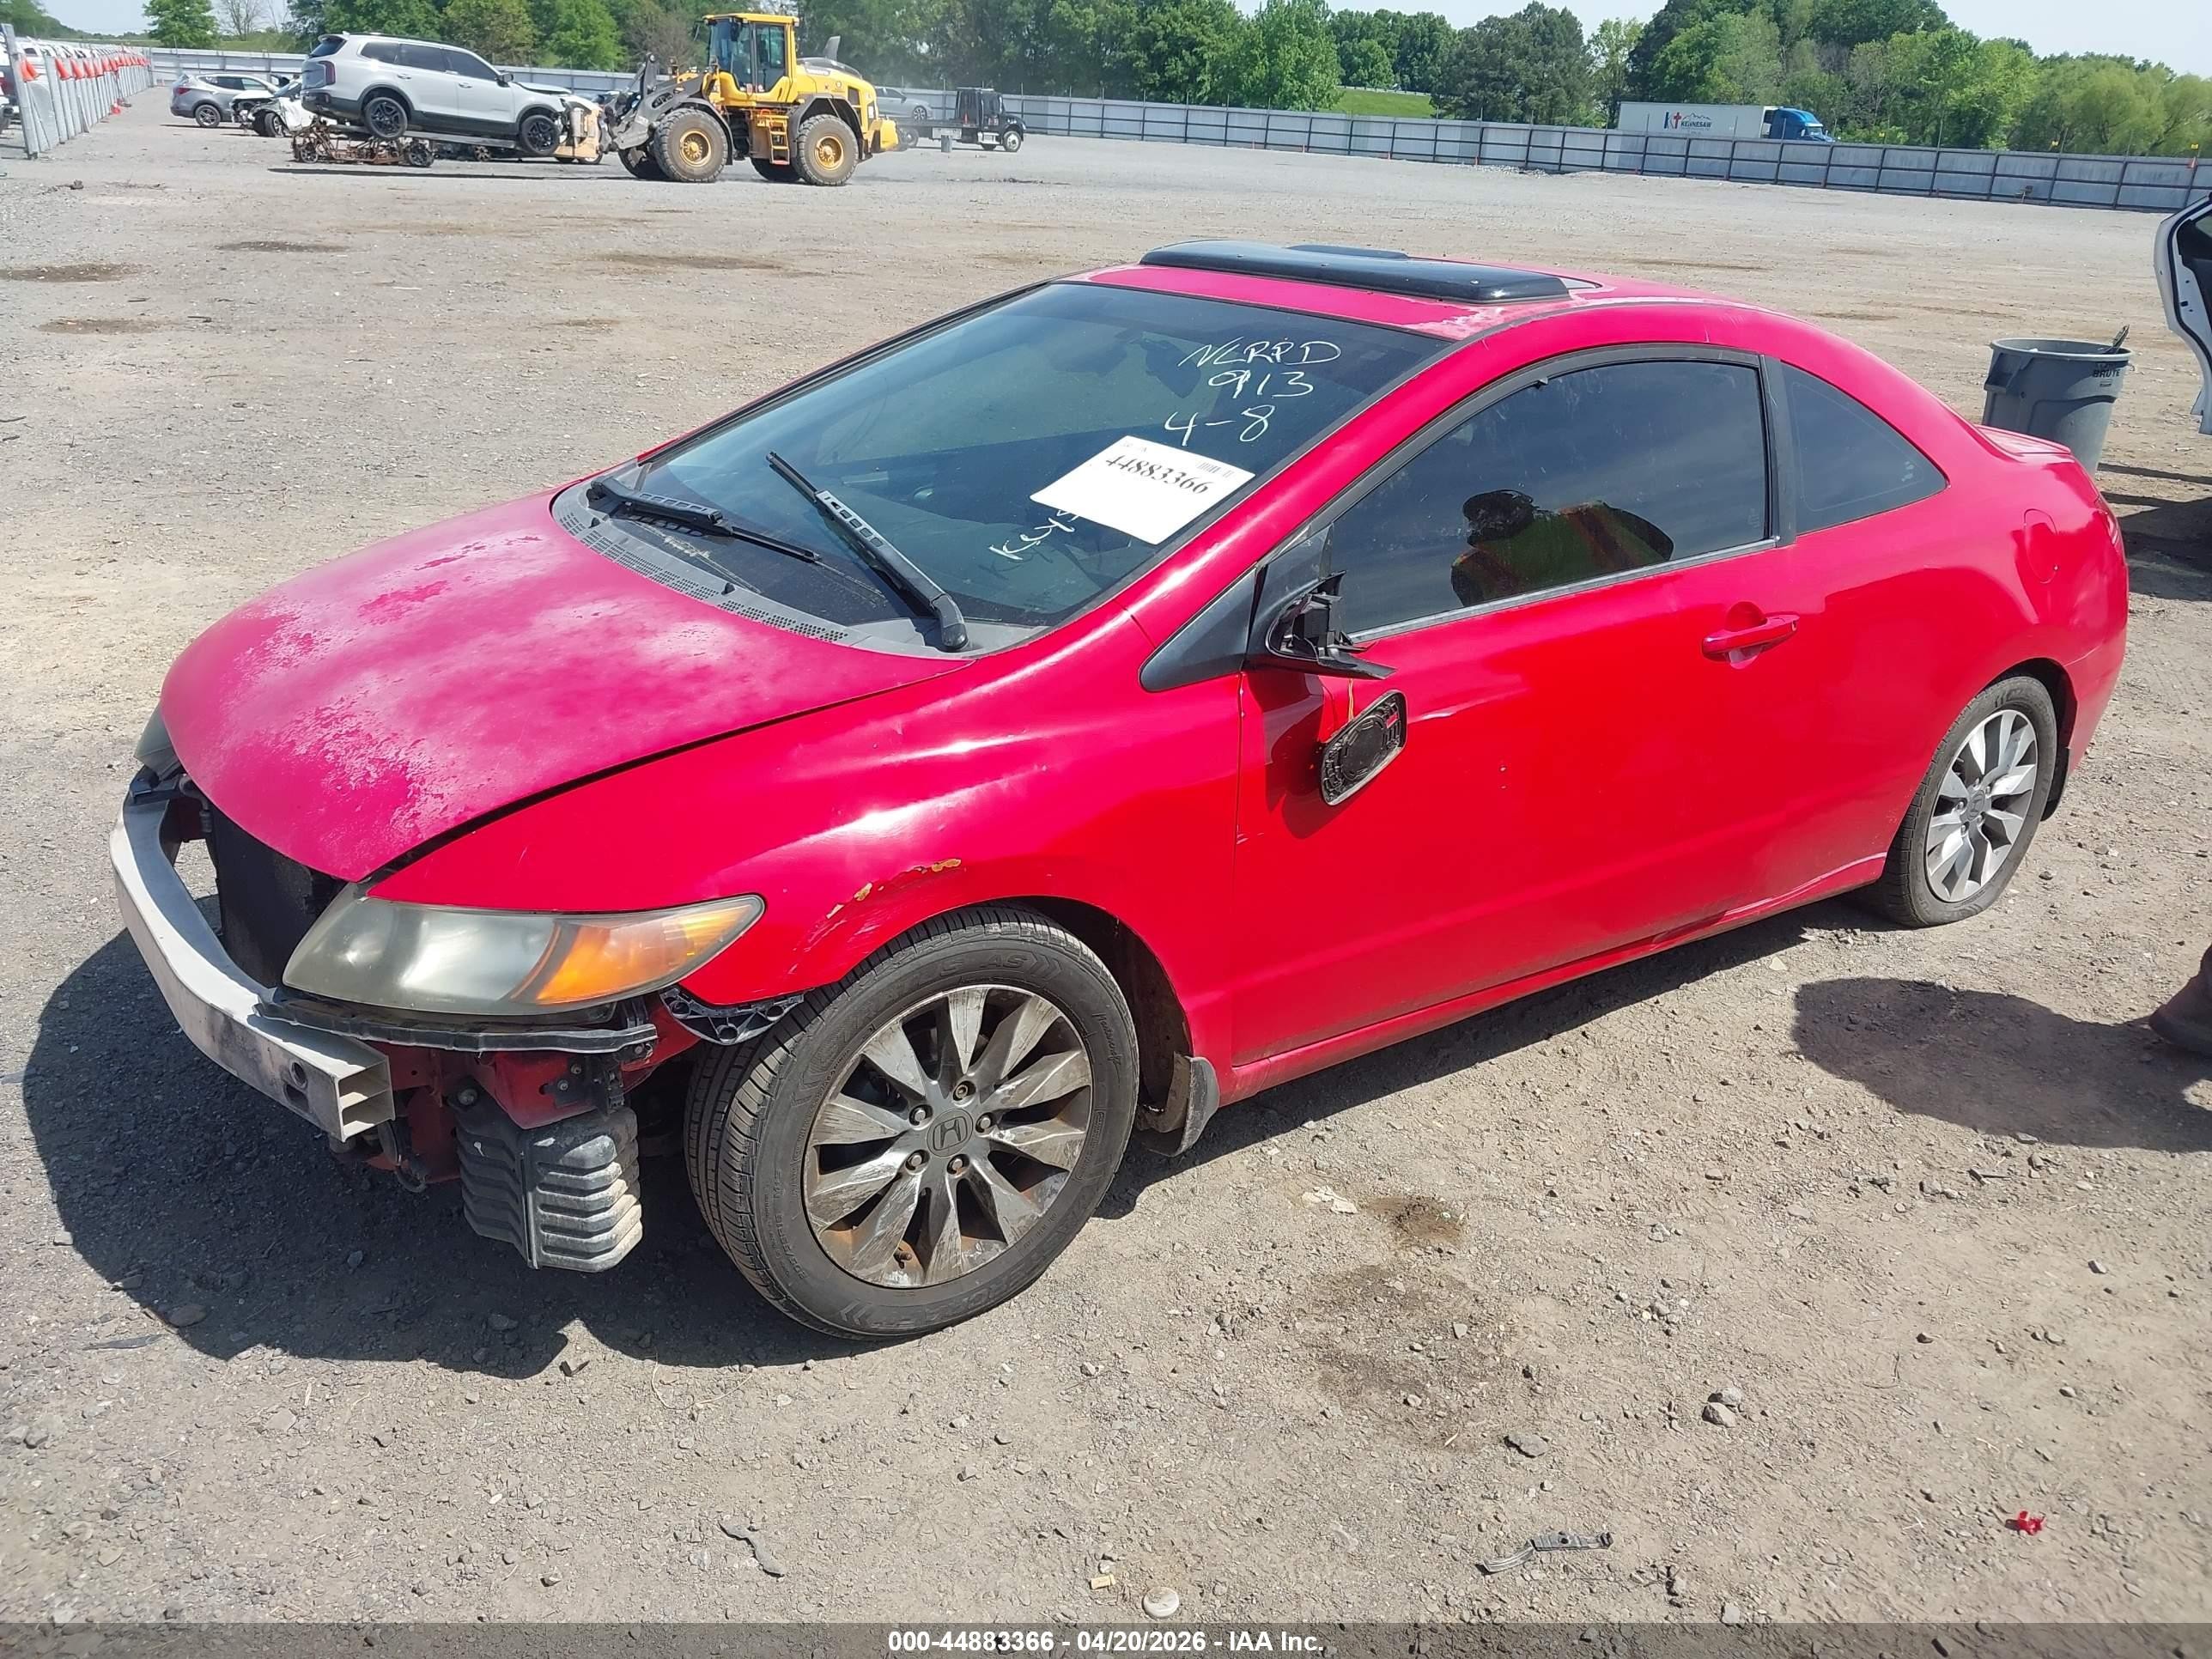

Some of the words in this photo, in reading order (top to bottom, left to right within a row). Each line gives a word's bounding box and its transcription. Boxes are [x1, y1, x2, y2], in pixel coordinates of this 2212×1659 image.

[1207, 368, 1314, 398] 913
[2093, 369, 2120, 378] BRUTE
[1105, 454, 1213, 495] 44883366
